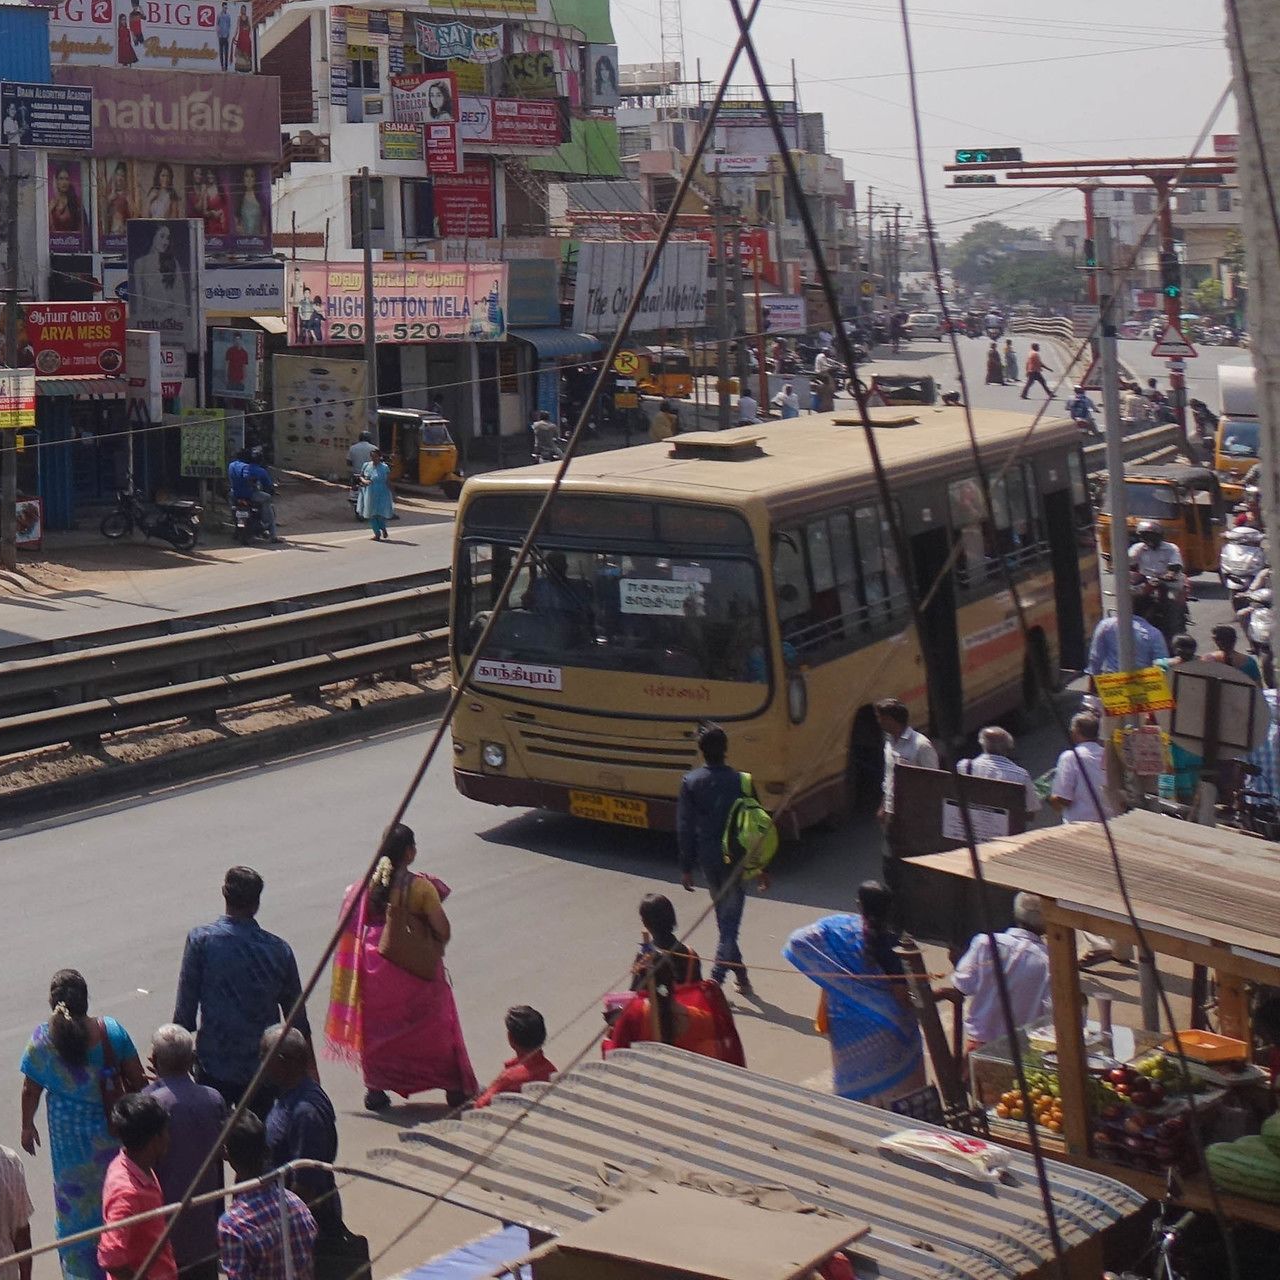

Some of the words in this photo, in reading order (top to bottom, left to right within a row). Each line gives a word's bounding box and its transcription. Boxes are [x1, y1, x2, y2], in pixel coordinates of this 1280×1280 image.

[146, 1, 191, 26] BIG
[93, 91, 245, 133] naturals
[461, 112, 486, 123] BEST
[385, 122, 417, 132] SAHAA
[327, 296, 365, 317] HIGH
[372, 296, 427, 317] COTTON
[432, 296, 471, 318] MELA
[41, 325, 75, 341] ARYA
[77, 324, 112, 340] MESS
[330, 322, 364, 340] 20
[392, 322, 441, 340] 520
[478, 663, 557, 684] காந்திபுரம்
